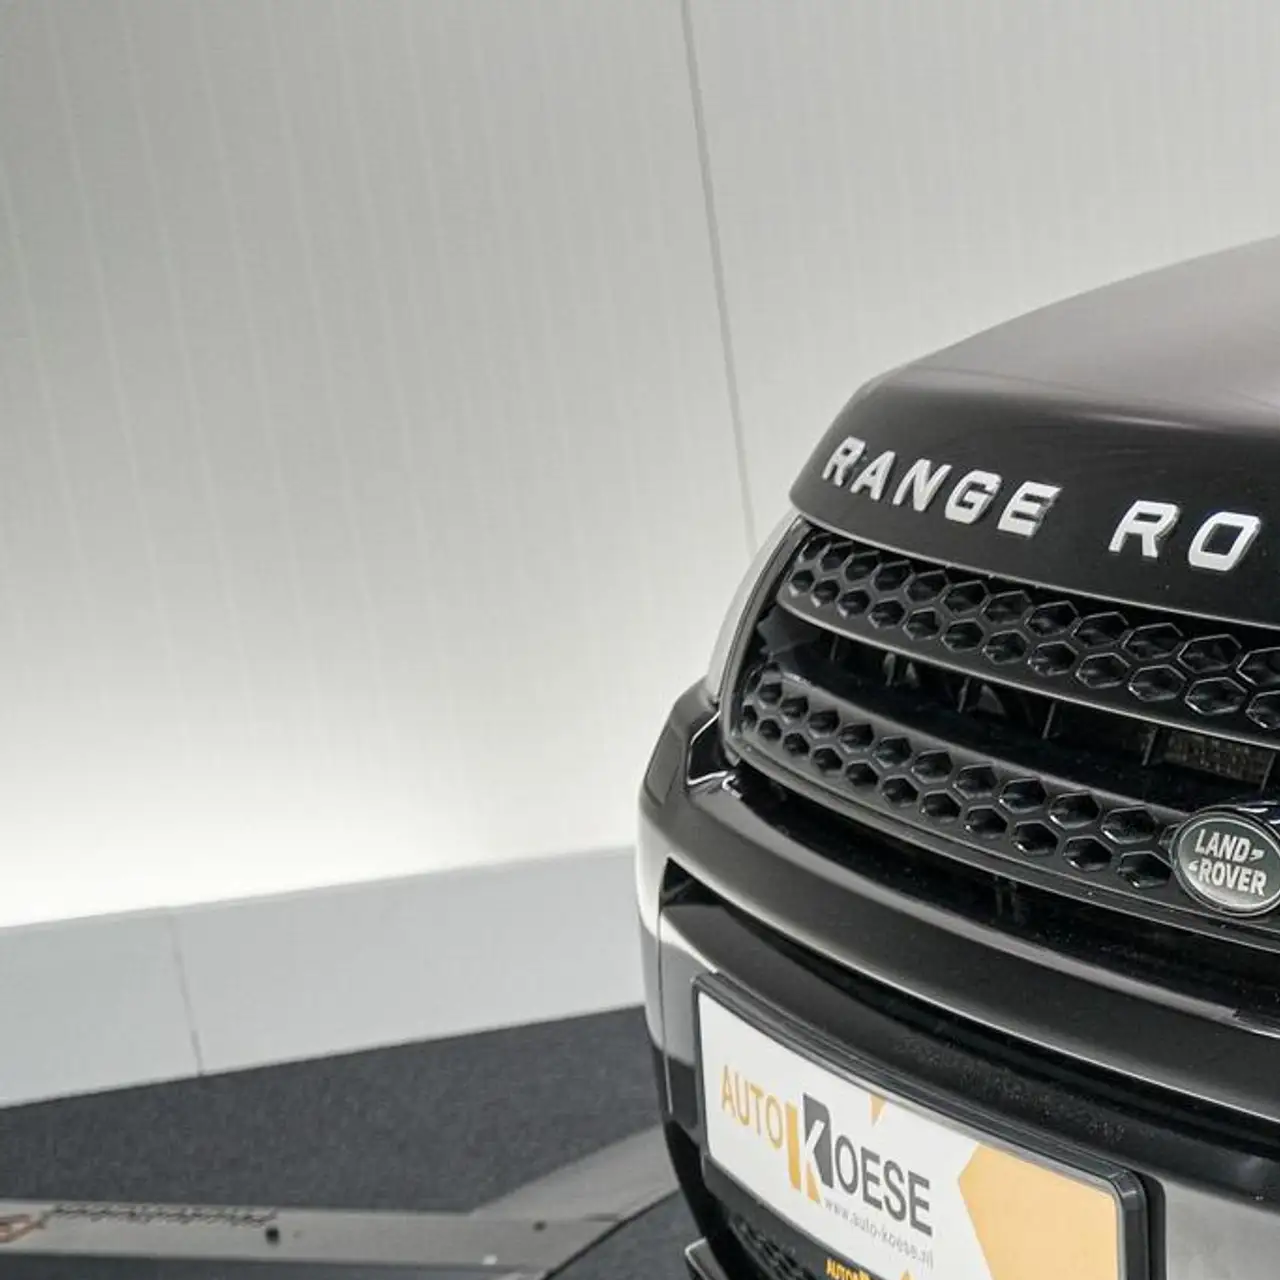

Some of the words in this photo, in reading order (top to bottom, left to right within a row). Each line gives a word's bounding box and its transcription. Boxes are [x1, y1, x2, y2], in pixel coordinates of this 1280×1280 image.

[822, 436, 1061, 536] RANGE
[1195, 829, 1250, 863] LAND
[1199, 858, 1267, 897] ROVER
